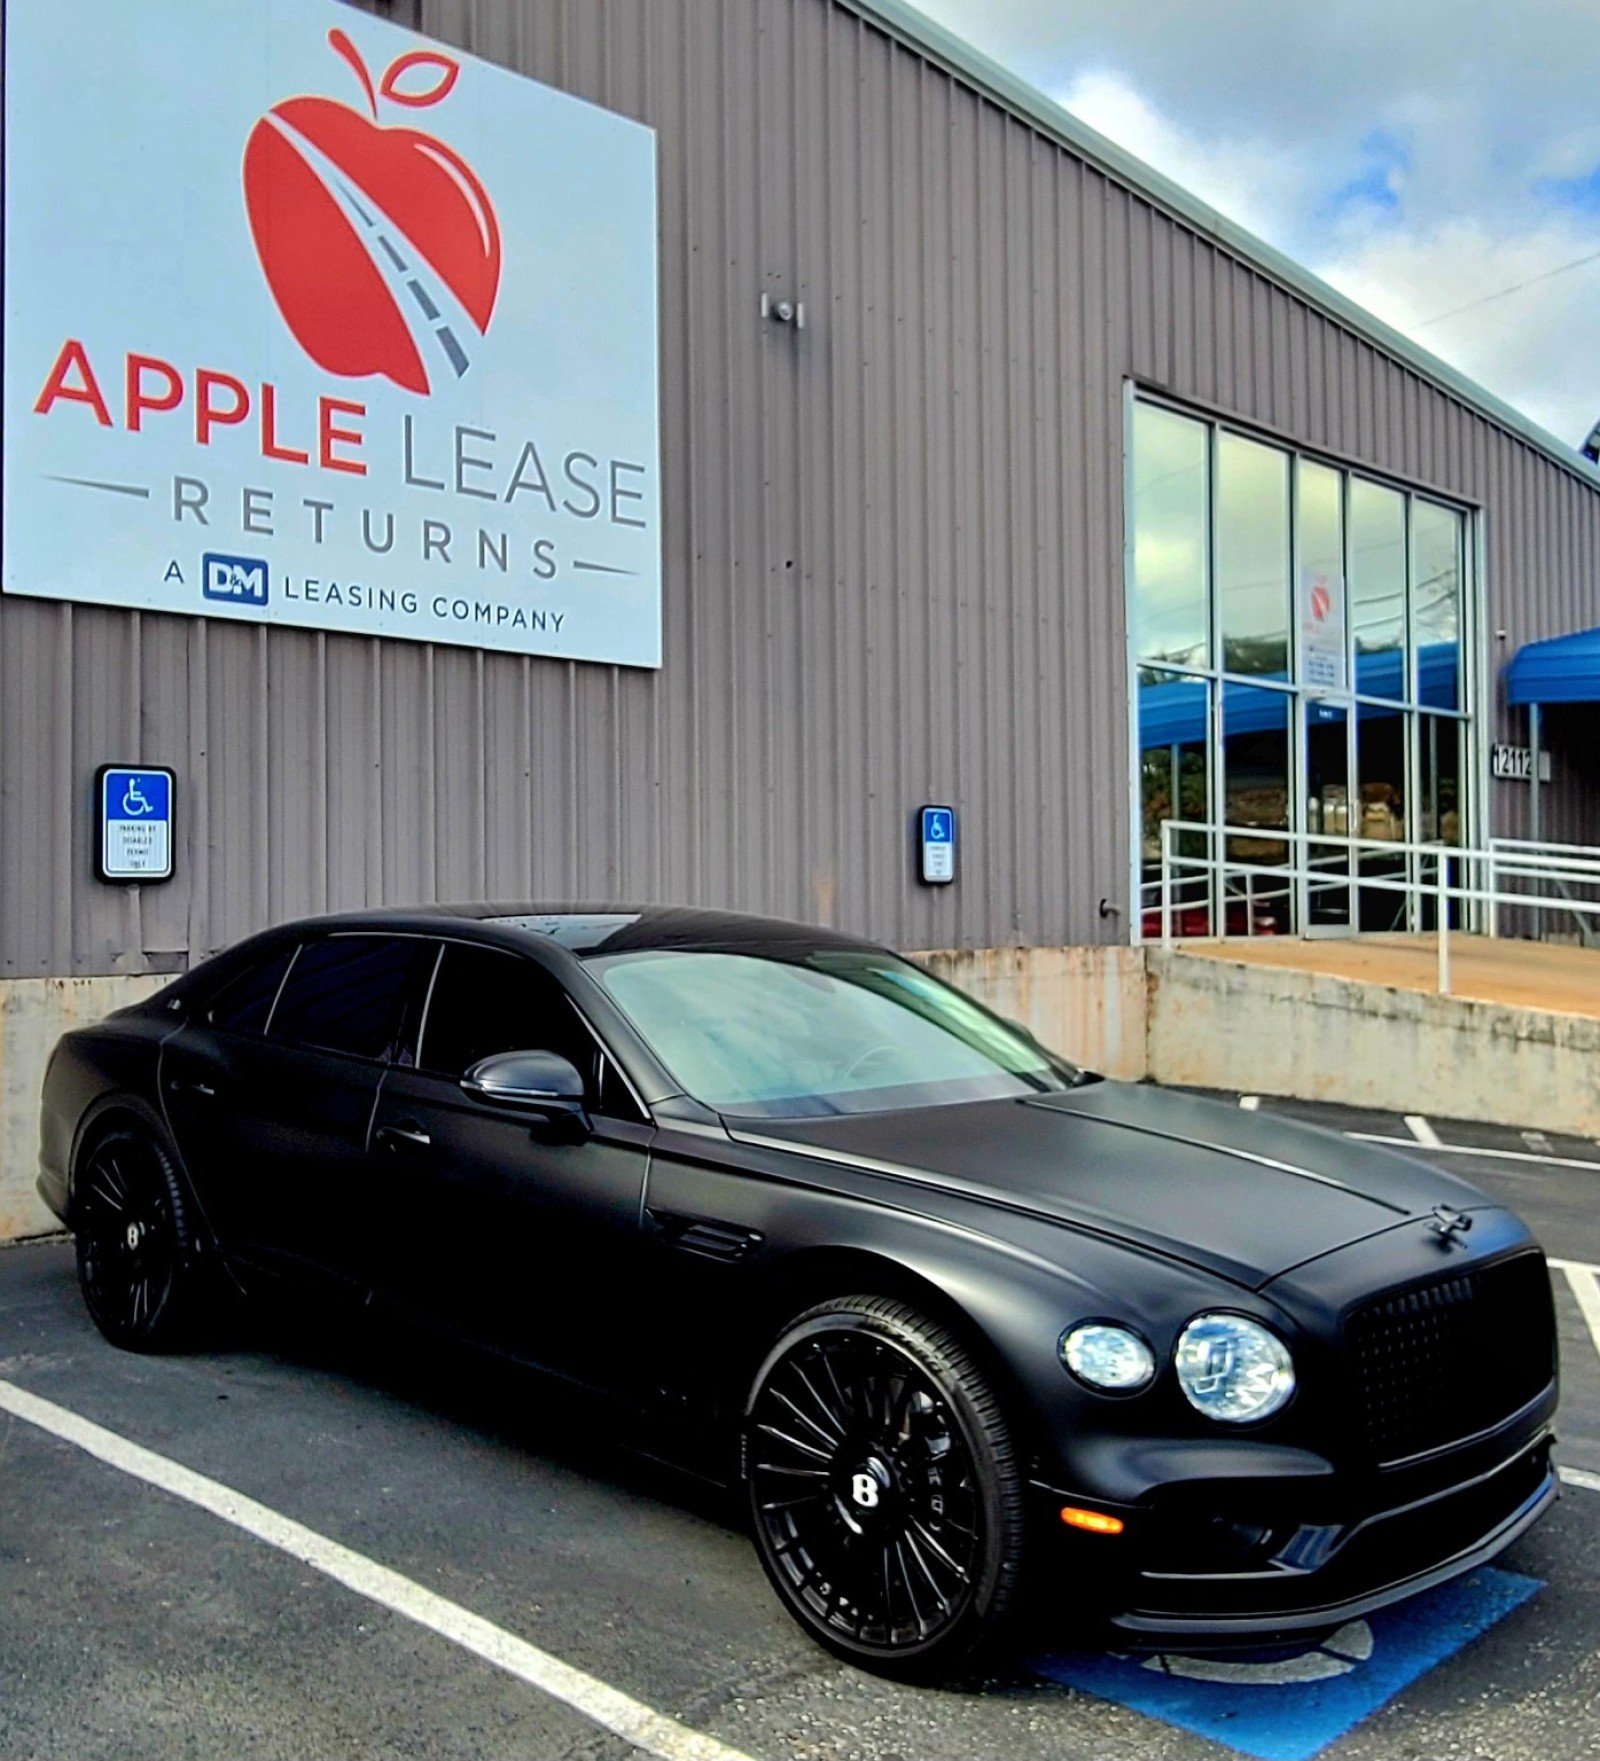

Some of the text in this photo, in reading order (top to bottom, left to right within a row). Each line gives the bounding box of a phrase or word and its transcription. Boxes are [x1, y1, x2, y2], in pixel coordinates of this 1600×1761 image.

[34, 338, 647, 529] APPLE LEASE
[173, 475, 558, 580] RETURNS
[163, 559, 185, 585] A
[284, 576, 418, 614] LEASING
[432, 596, 566, 633] COMPANY
[852, 1473, 879, 1507] B
